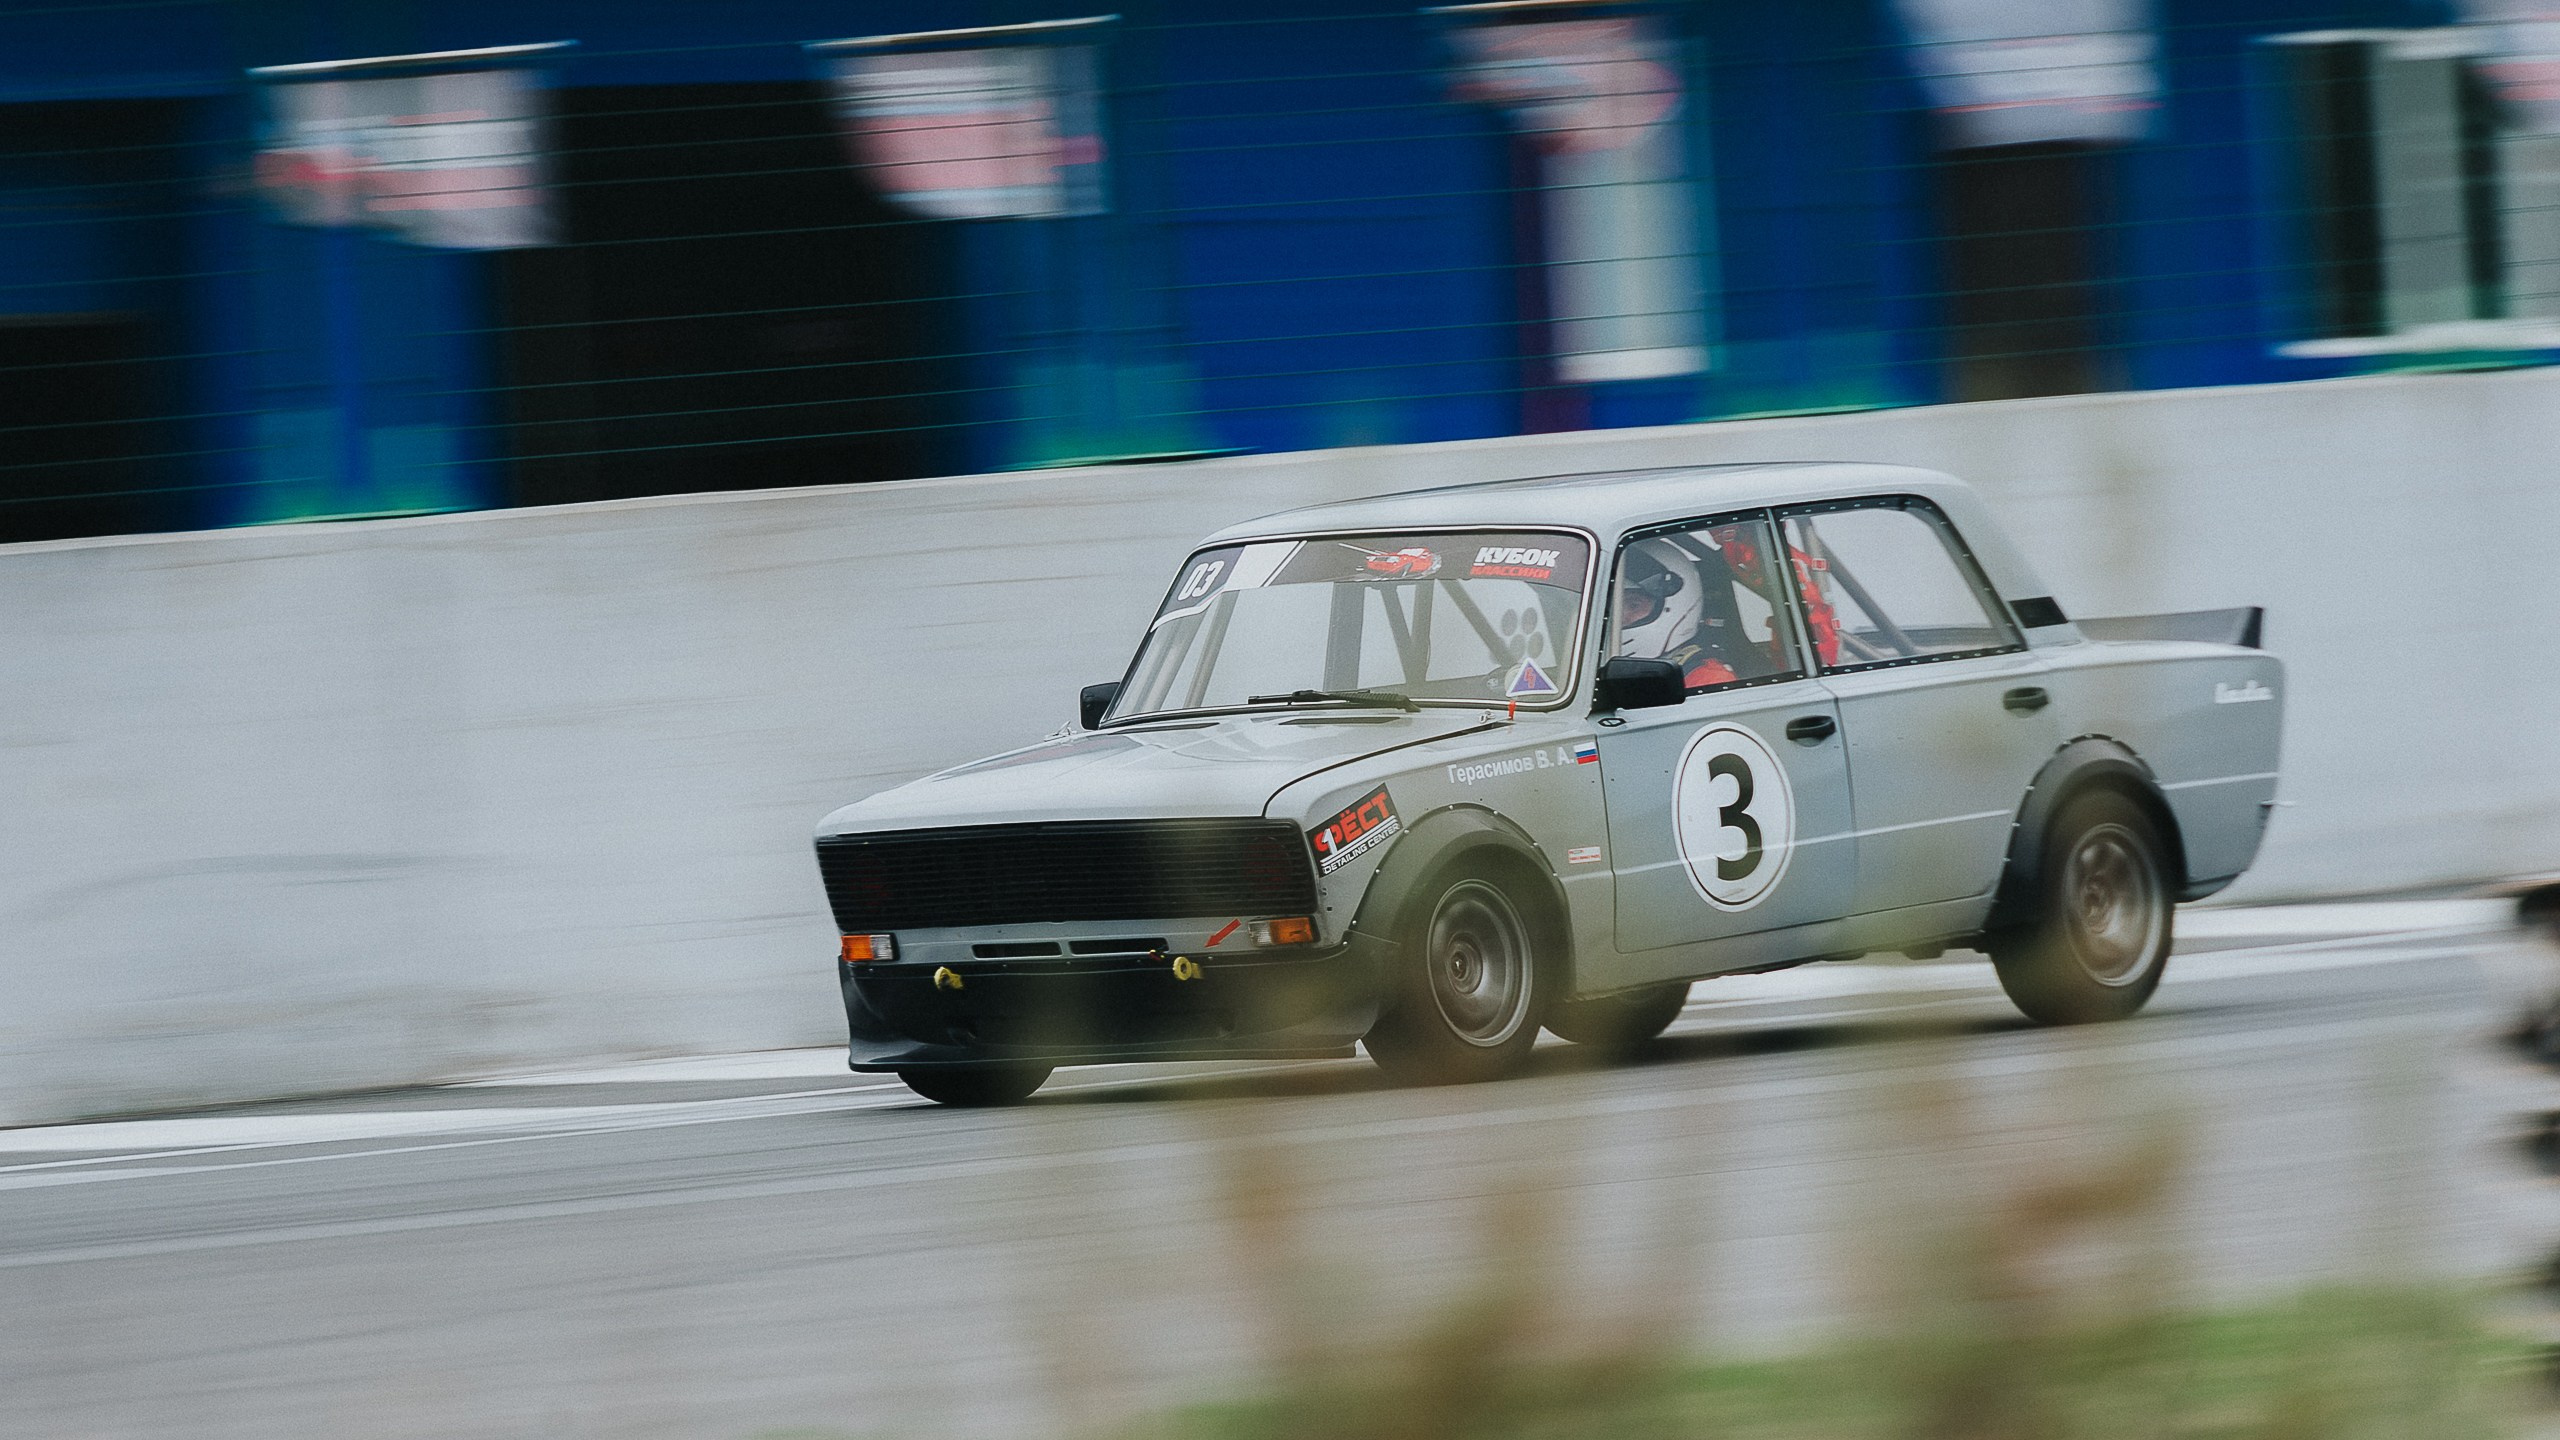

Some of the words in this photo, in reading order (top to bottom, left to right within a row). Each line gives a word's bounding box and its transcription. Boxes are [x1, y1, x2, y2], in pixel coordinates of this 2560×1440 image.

[1475, 547, 1560, 567] КУБОК
[1178, 560, 1225, 601] 03
[1446, 756, 1535, 786] Герасимов
[1534, 749, 1554, 769] В.
[1557, 746, 1574, 765] А.
[1707, 753, 1763, 881] 3
[1323, 843, 1368, 875] DETAILING
[1367, 822, 1400, 848] CENTER
